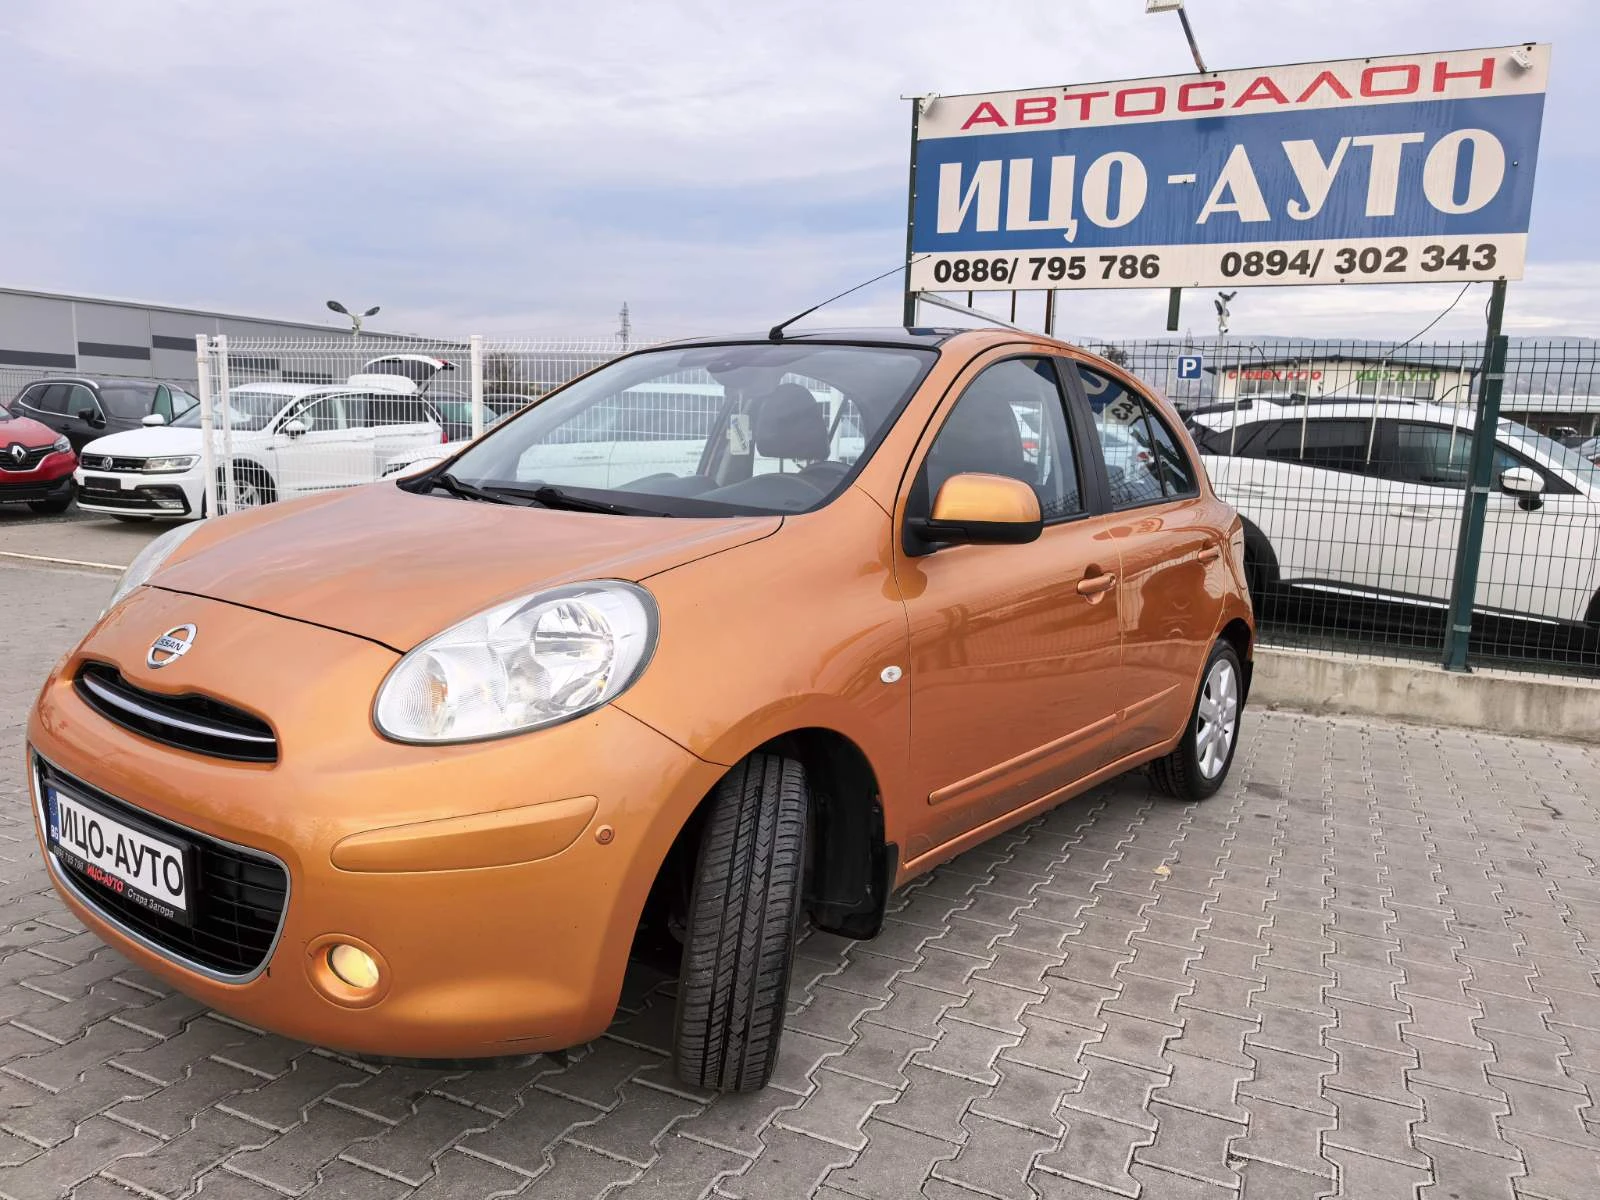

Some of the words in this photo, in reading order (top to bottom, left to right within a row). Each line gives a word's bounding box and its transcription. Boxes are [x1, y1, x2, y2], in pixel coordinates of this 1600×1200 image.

[959, 57, 1496, 130] АВТОСАЛОН
[933, 257, 1019, 284] 0886/
[1029, 256, 1086, 281] 795
[1100, 254, 1160, 279] 786
[1220, 248, 1324, 277] 0894/
[1334, 246, 1408, 274] 302
[1421, 243, 1497, 272] 343
[1180, 359, 1197, 376] P
[50, 824, 59, 840] BG
[59, 802, 184, 897] ИЦО-АУТО
[86, 863, 124, 893] ИЦО-АУТО
[127, 888, 148, 906] Стара
[149, 898, 175, 919] Загора
